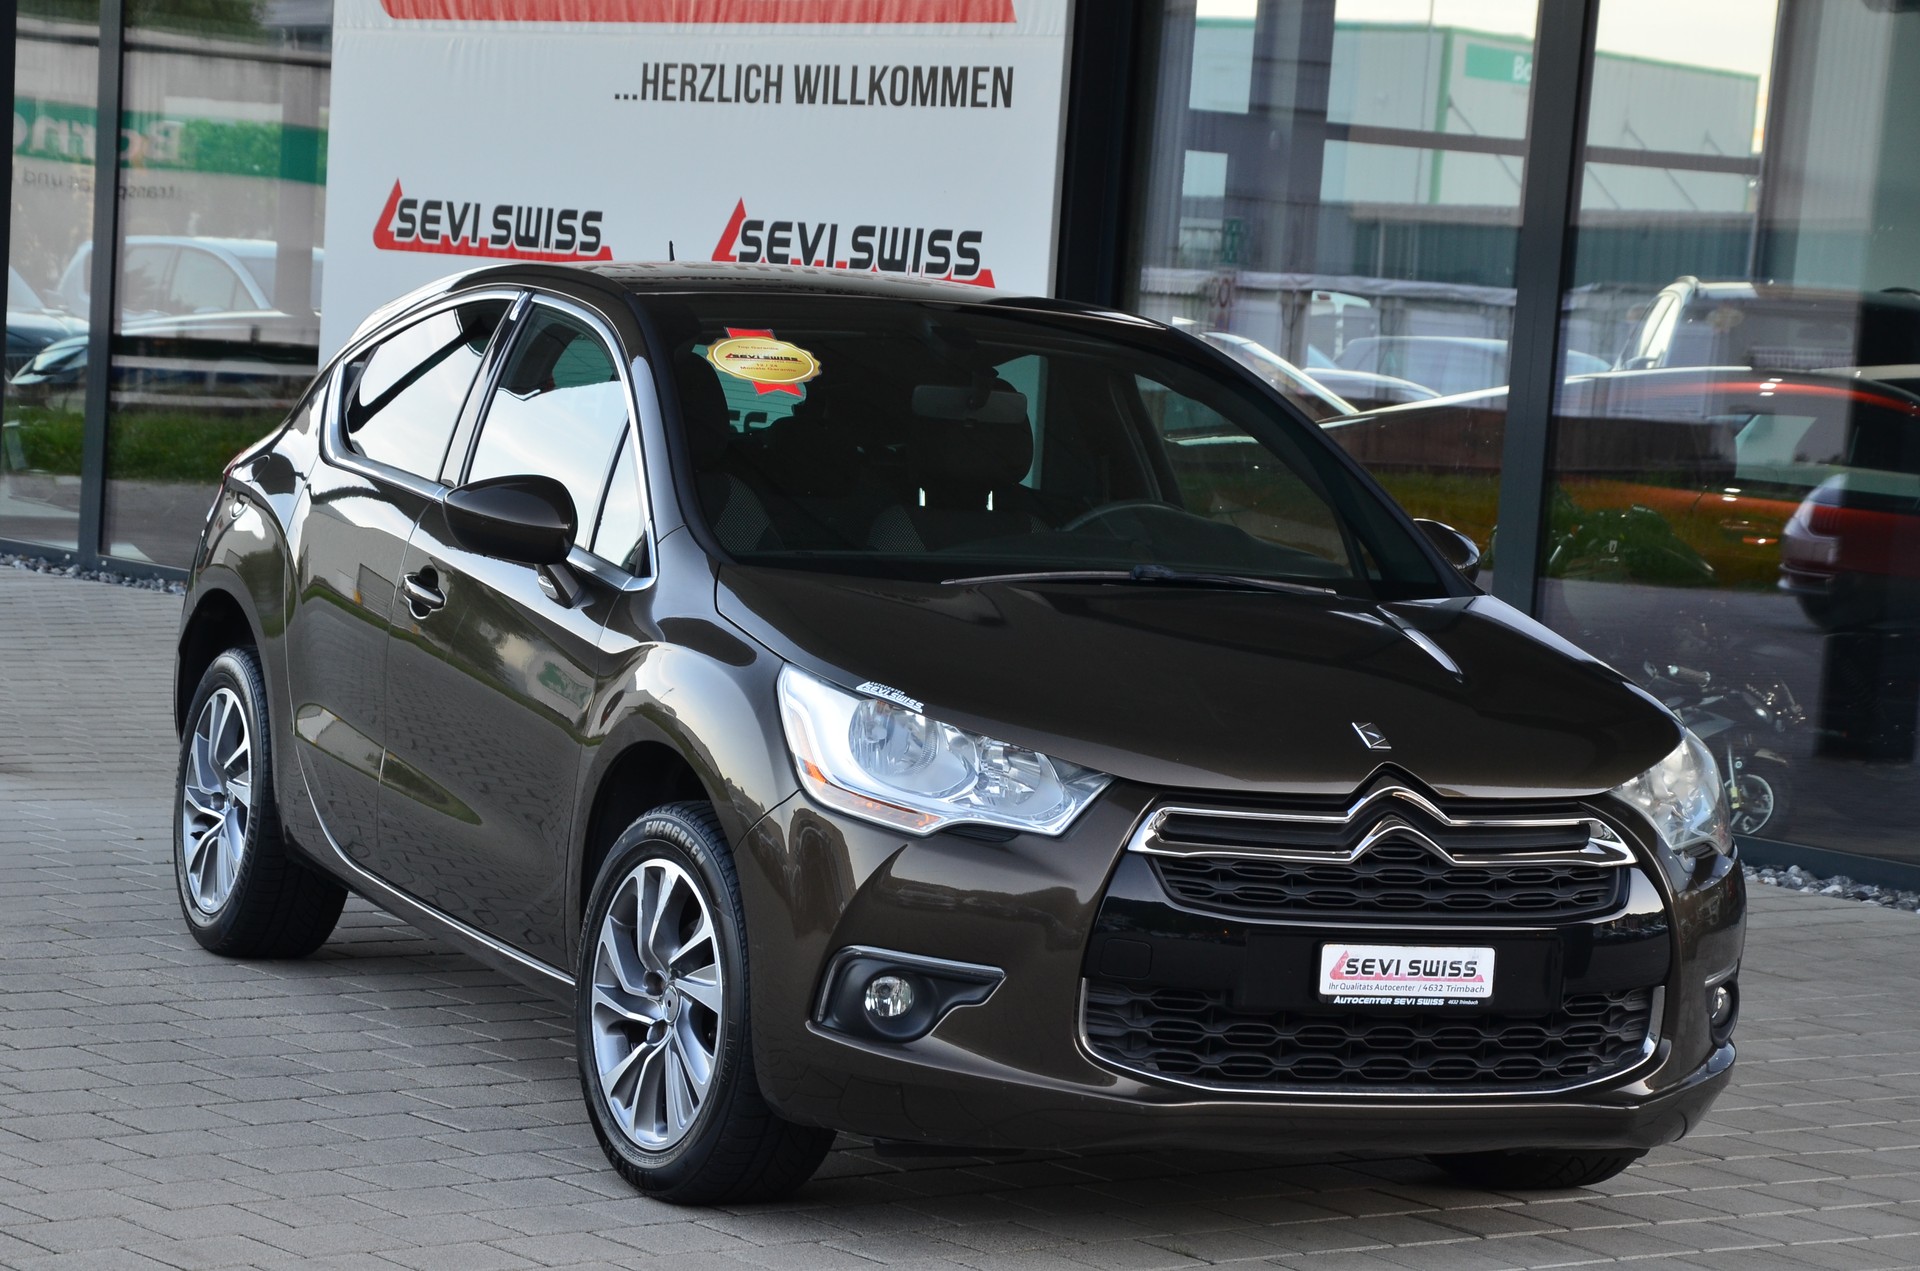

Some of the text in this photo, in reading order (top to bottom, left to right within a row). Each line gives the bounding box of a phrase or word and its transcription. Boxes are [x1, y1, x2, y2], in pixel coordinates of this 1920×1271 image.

[793, 64, 1015, 109] WILLKOMMEN
[395, 198, 604, 254] SEVI SWISS
[737, 219, 984, 277] SEVI SWISS
[863, 683, 925, 710] SEVI SWISS
[644, 820, 707, 866] EVERGREEN
[1344, 958, 1478, 978] SEVI SWISS
[1374, 983, 1415, 992] Autocenter
[1422, 983, 1444, 992] 4632
[1446, 984, 1485, 993] Trimbach
[1393, 997, 1416, 1006] SEVI
[1416, 998, 1445, 1006] SWISS
